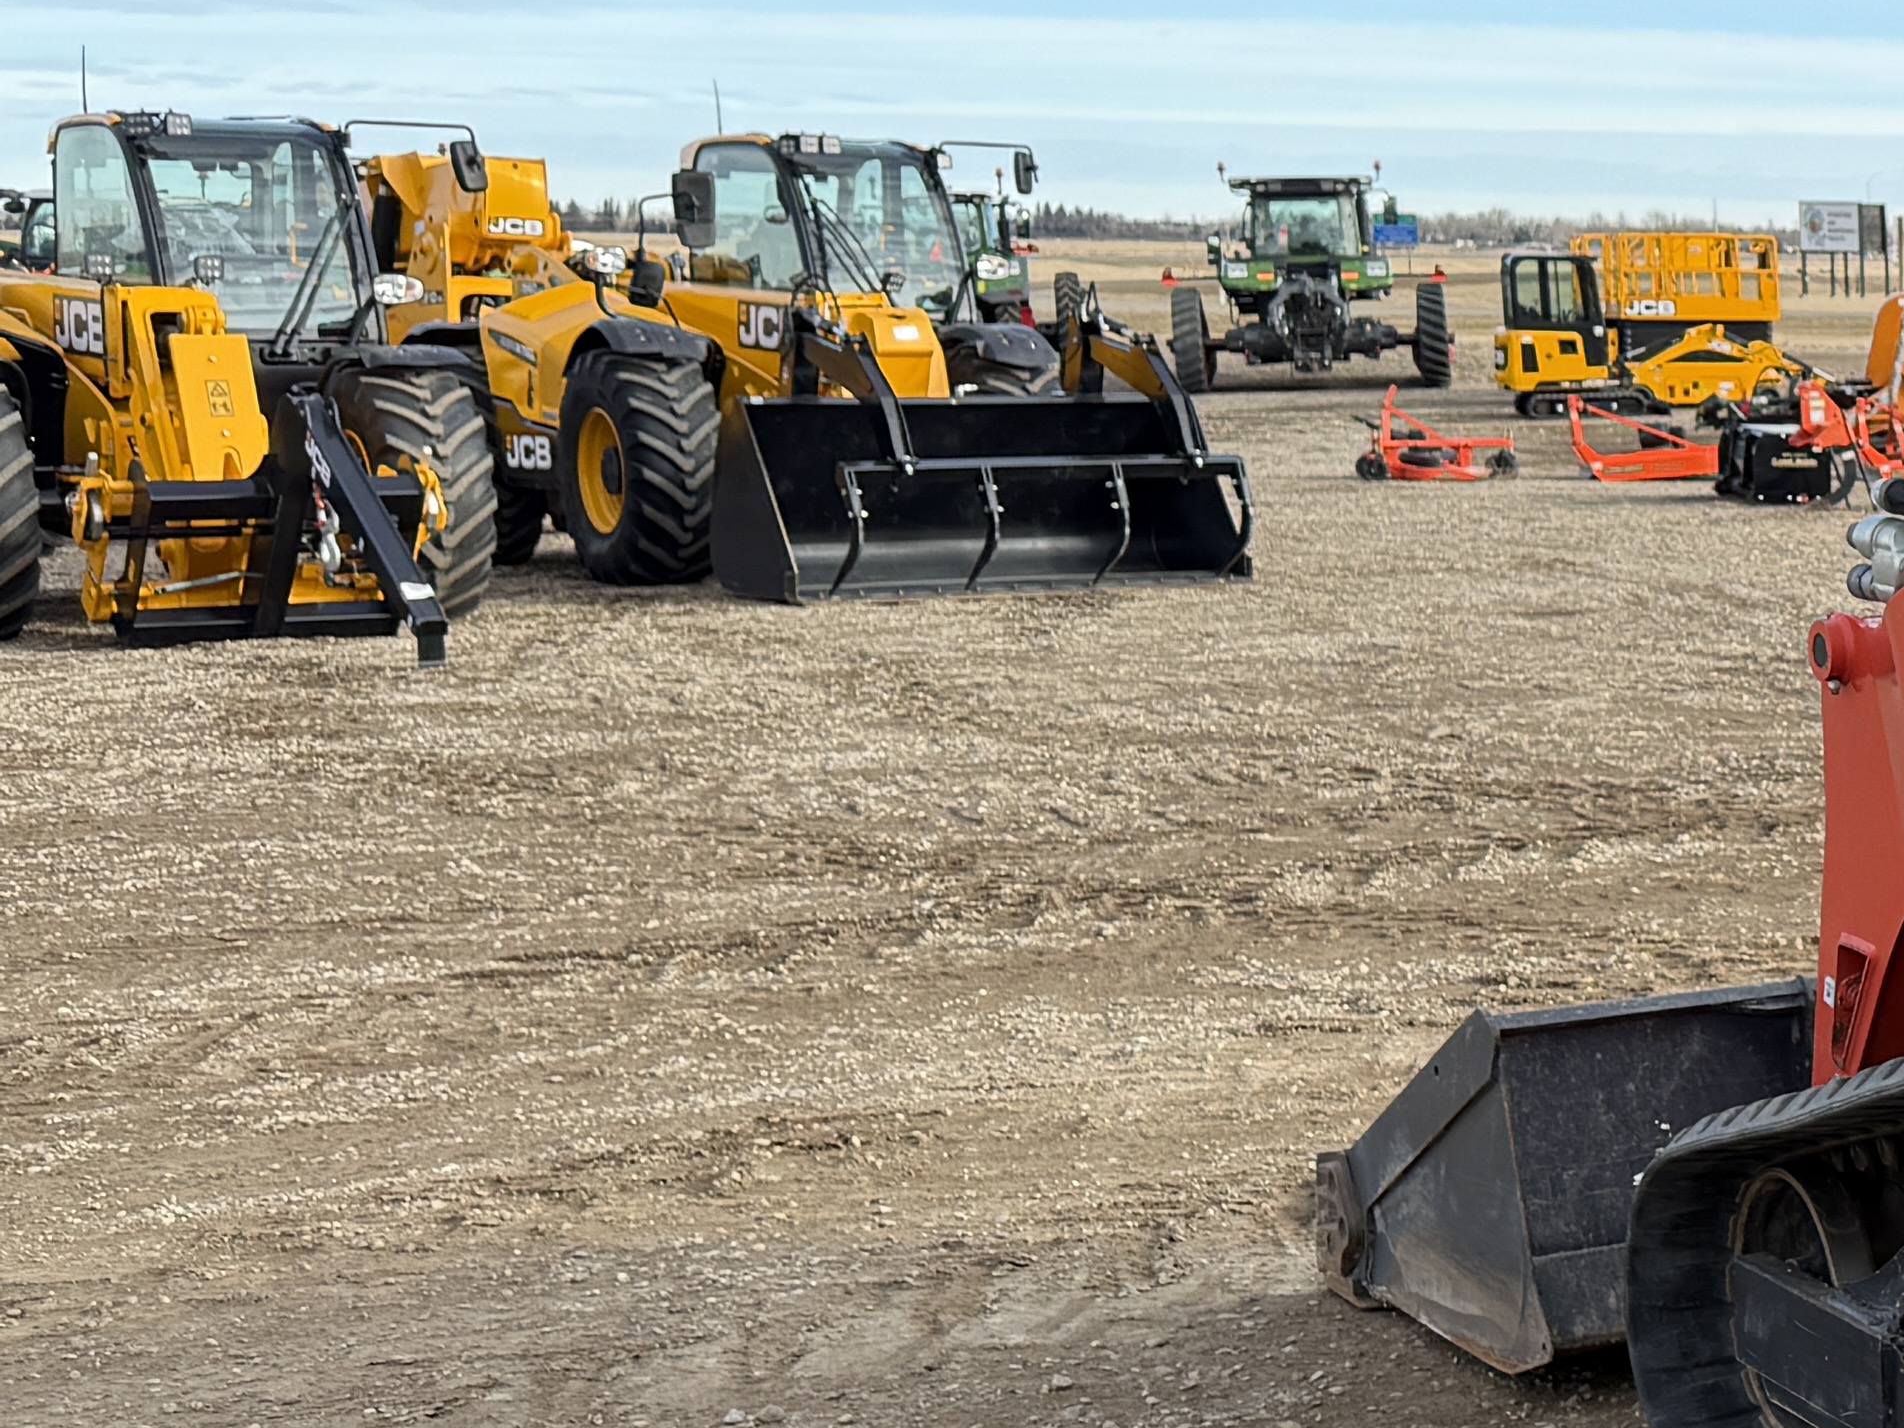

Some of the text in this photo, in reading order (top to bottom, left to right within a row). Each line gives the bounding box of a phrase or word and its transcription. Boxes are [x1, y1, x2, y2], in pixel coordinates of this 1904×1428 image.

[489, 217, 543, 236] JCB
[1625, 299, 1676, 316] JCB
[739, 303, 784, 350] JC
[304, 430, 331, 489] JCB
[506, 434, 552, 470] JCB
